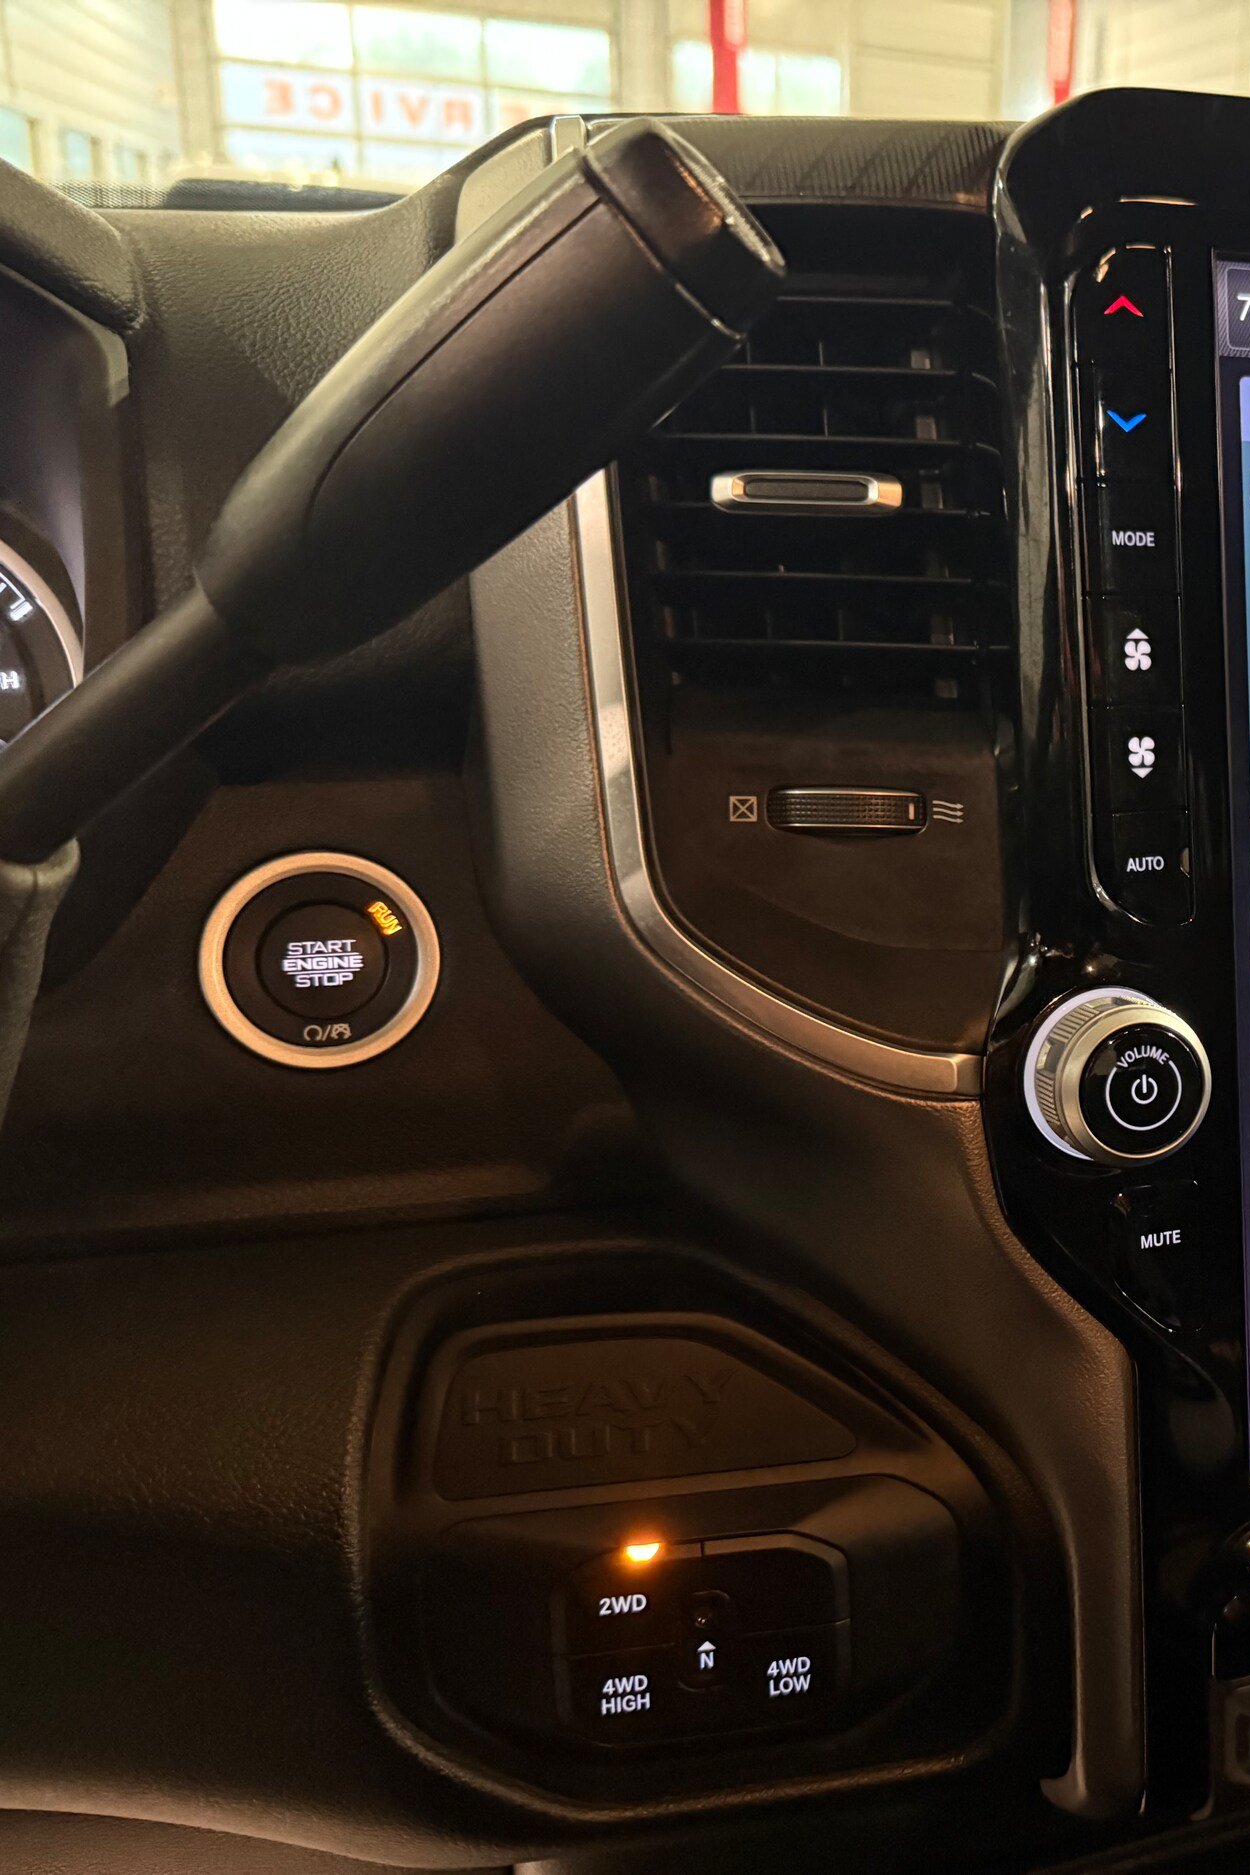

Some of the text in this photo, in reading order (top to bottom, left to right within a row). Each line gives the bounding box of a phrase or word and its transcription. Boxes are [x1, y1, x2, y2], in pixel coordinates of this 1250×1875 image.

[1112, 530, 1156, 548] MODE
[1126, 855, 1165, 873] AUTO
[368, 901, 403, 937] RUN
[286, 939, 357, 956] START
[282, 955, 364, 973] ENGINE
[295, 972, 354, 988] STOP
[1116, 1045, 1171, 1070] VOLUME
[1140, 1229, 1182, 1250] MUTE
[461, 1368, 736, 1426] HEAVY
[500, 1416, 720, 1465] DUTY
[599, 1593, 648, 1616] 2WD
[699, 1651, 715, 1669] N
[766, 1655, 812, 1678] 4WD
[602, 1674, 648, 1697] 4WD
[769, 1673, 812, 1698] LOW
[601, 1692, 650, 1716] HIGH
